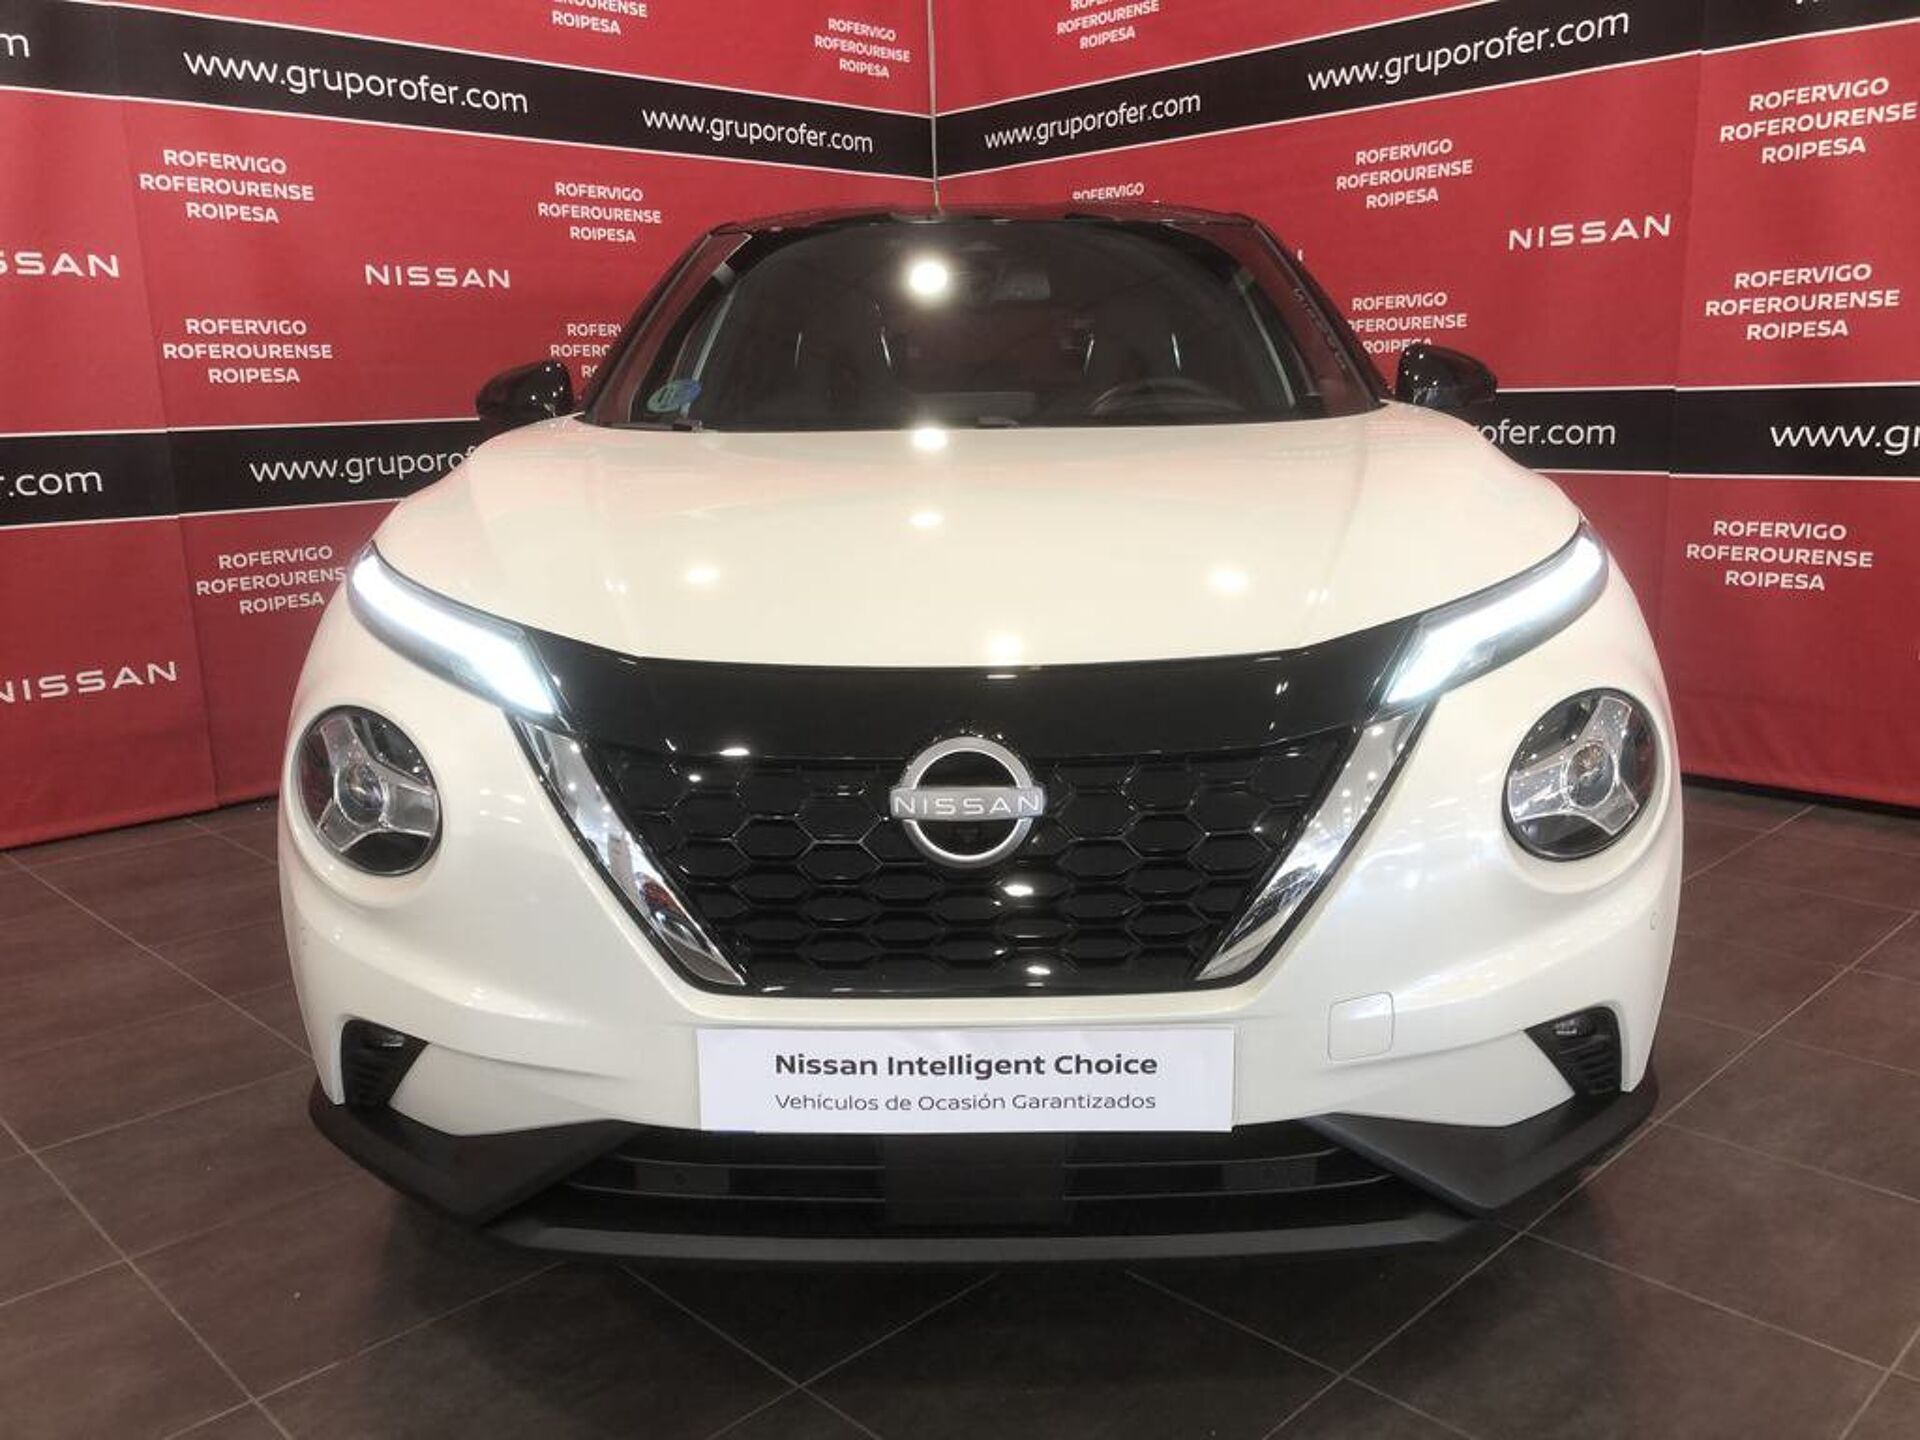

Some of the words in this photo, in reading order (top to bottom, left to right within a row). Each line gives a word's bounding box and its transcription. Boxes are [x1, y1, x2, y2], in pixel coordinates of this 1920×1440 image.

[552, 11, 621, 34] ROIPESA
[827, 18, 897, 42] ROFERVIGO
[1056, 1, 1160, 35] ROFEROURENSE
[814, 34, 911, 63] ROFEROURENSE
[1079, 26, 1136, 49] ROIPESA
[1307, 11, 1630, 92] www.gruporofer.com
[839, 58, 890, 79] ROIPESA
[183, 51, 529, 114] www.gruporofer.com
[1749, 77, 1890, 112] ROFERVIGO
[642, 109, 874, 154] www.gruporofer.com
[984, 94, 1201, 151] www.gruporofer.com
[1720, 102, 1917, 142] ROFEROURENSE
[163, 149, 287, 174] ROFERVIGO
[1355, 138, 1453, 166] ROFERVIGO
[1761, 136, 1866, 164] ROIPESA
[1336, 159, 1473, 190] ROFEROURENSE
[139, 173, 314, 201] ROFEROURENSE
[554, 182, 644, 202] ROFERVIGO
[1365, 187, 1439, 209] ROIPESA
[186, 202, 279, 223] ROIPESA
[538, 202, 661, 224] ROFEROURENSE
[570, 227, 636, 243] ROIPESA
[1508, 214, 1671, 250] NISSAN
[365, 264, 510, 288] NISSAN
[1734, 263, 1873, 289] ROFERVIGO
[1352, 292, 1448, 311] ROFERVIGO
[1705, 290, 1900, 316] ROFEROURENSE
[186, 319, 307, 335] ROFERVIGO
[1746, 320, 1849, 340] ROIPESA
[163, 343, 333, 359] ROFEROURENSE
[208, 368, 300, 384] ROIPESA
[1713, 520, 1847, 541] ROFERVIGO
[218, 546, 333, 570] ROFERVIGO
[1686, 544, 1873, 568] ROFEROURENSE
[1725, 571, 1825, 591] ROIPESA
[239, 592, 325, 615] ROIPESA
[894, 795, 1040, 815] NISSAN
[775, 1053, 878, 1075] Nissan
[887, 1053, 1046, 1081] Intelligent
[1054, 1053, 1158, 1075] Choice
[775, 1094, 879, 1111] Vehículos
[885, 1095, 912, 1111] de
[918, 1093, 1006, 1111] Ocasión
[1012, 1094, 1156, 1110] Garantizados
